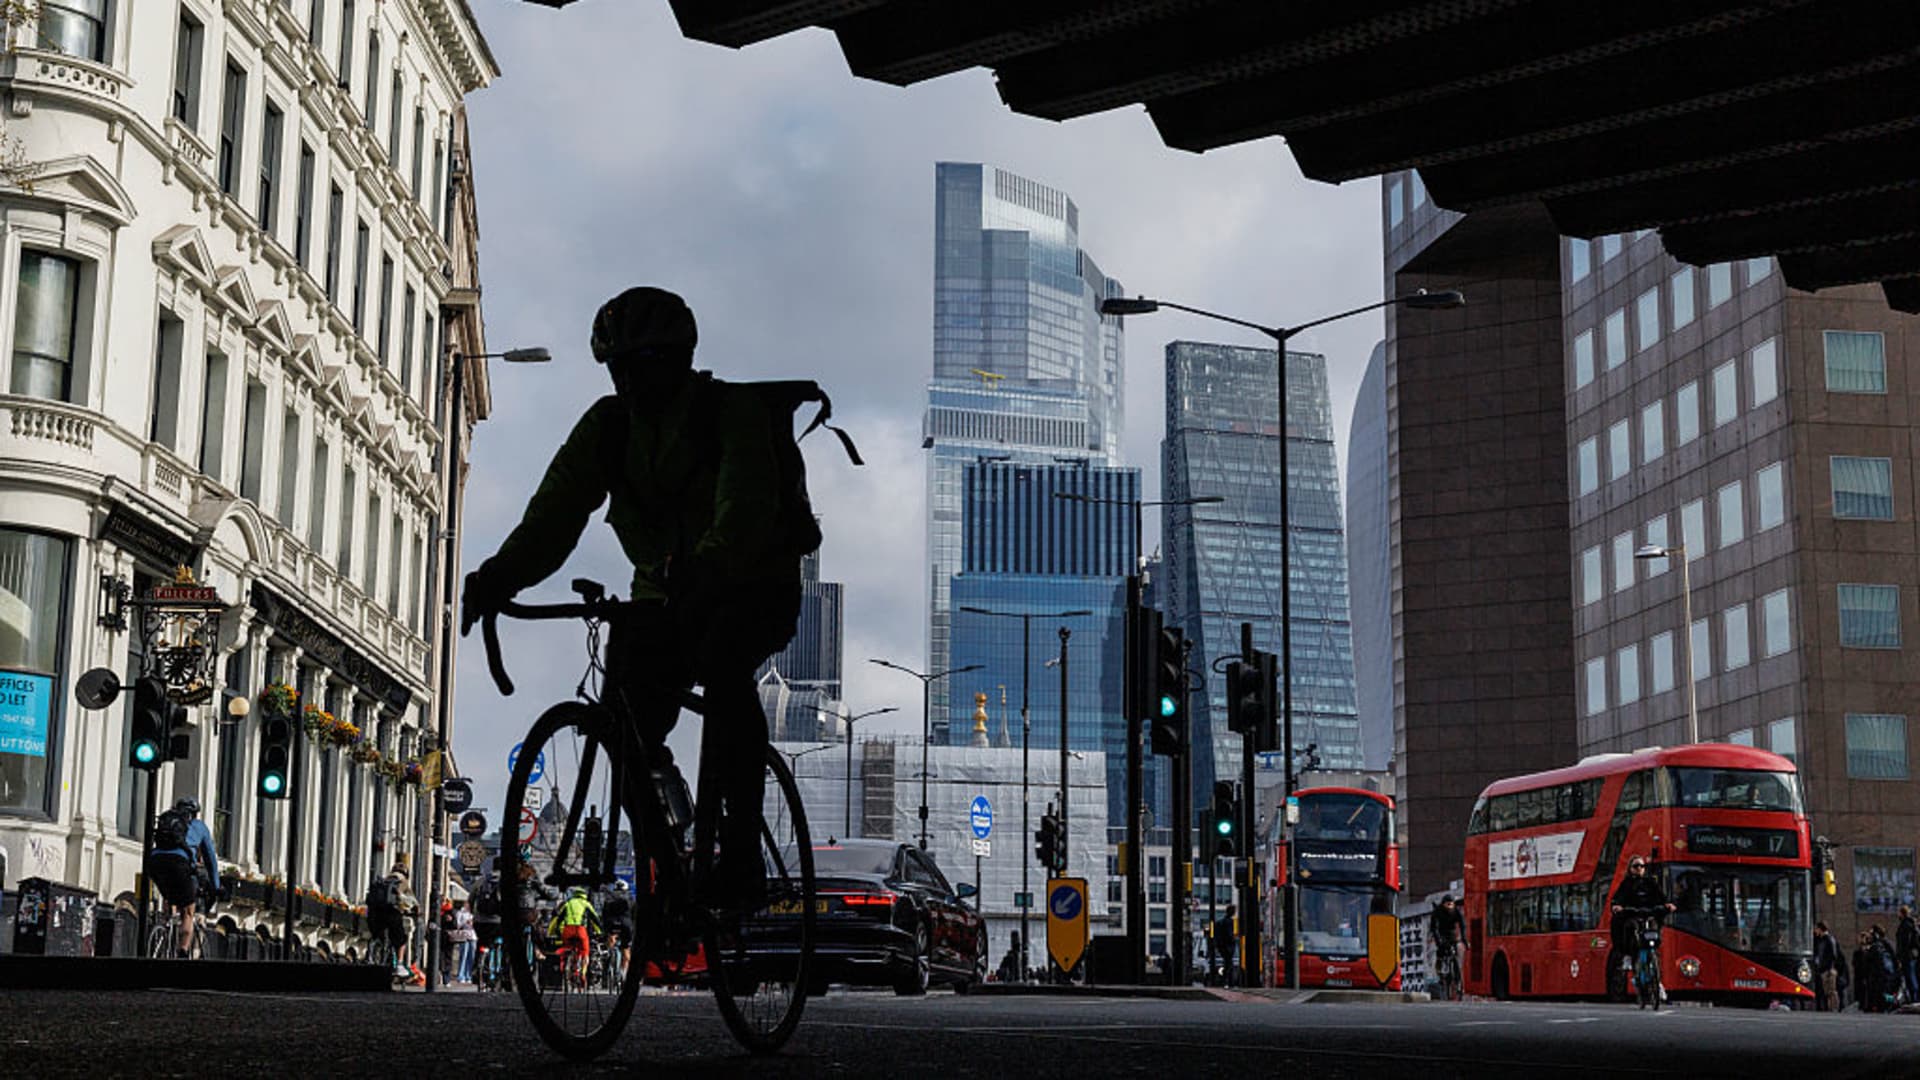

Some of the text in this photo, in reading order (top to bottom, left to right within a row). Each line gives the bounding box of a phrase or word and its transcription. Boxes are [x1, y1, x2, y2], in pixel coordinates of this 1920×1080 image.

[9, 693, 26, 705] LET
[1696, 833, 1784, 853] London Bridge 17
